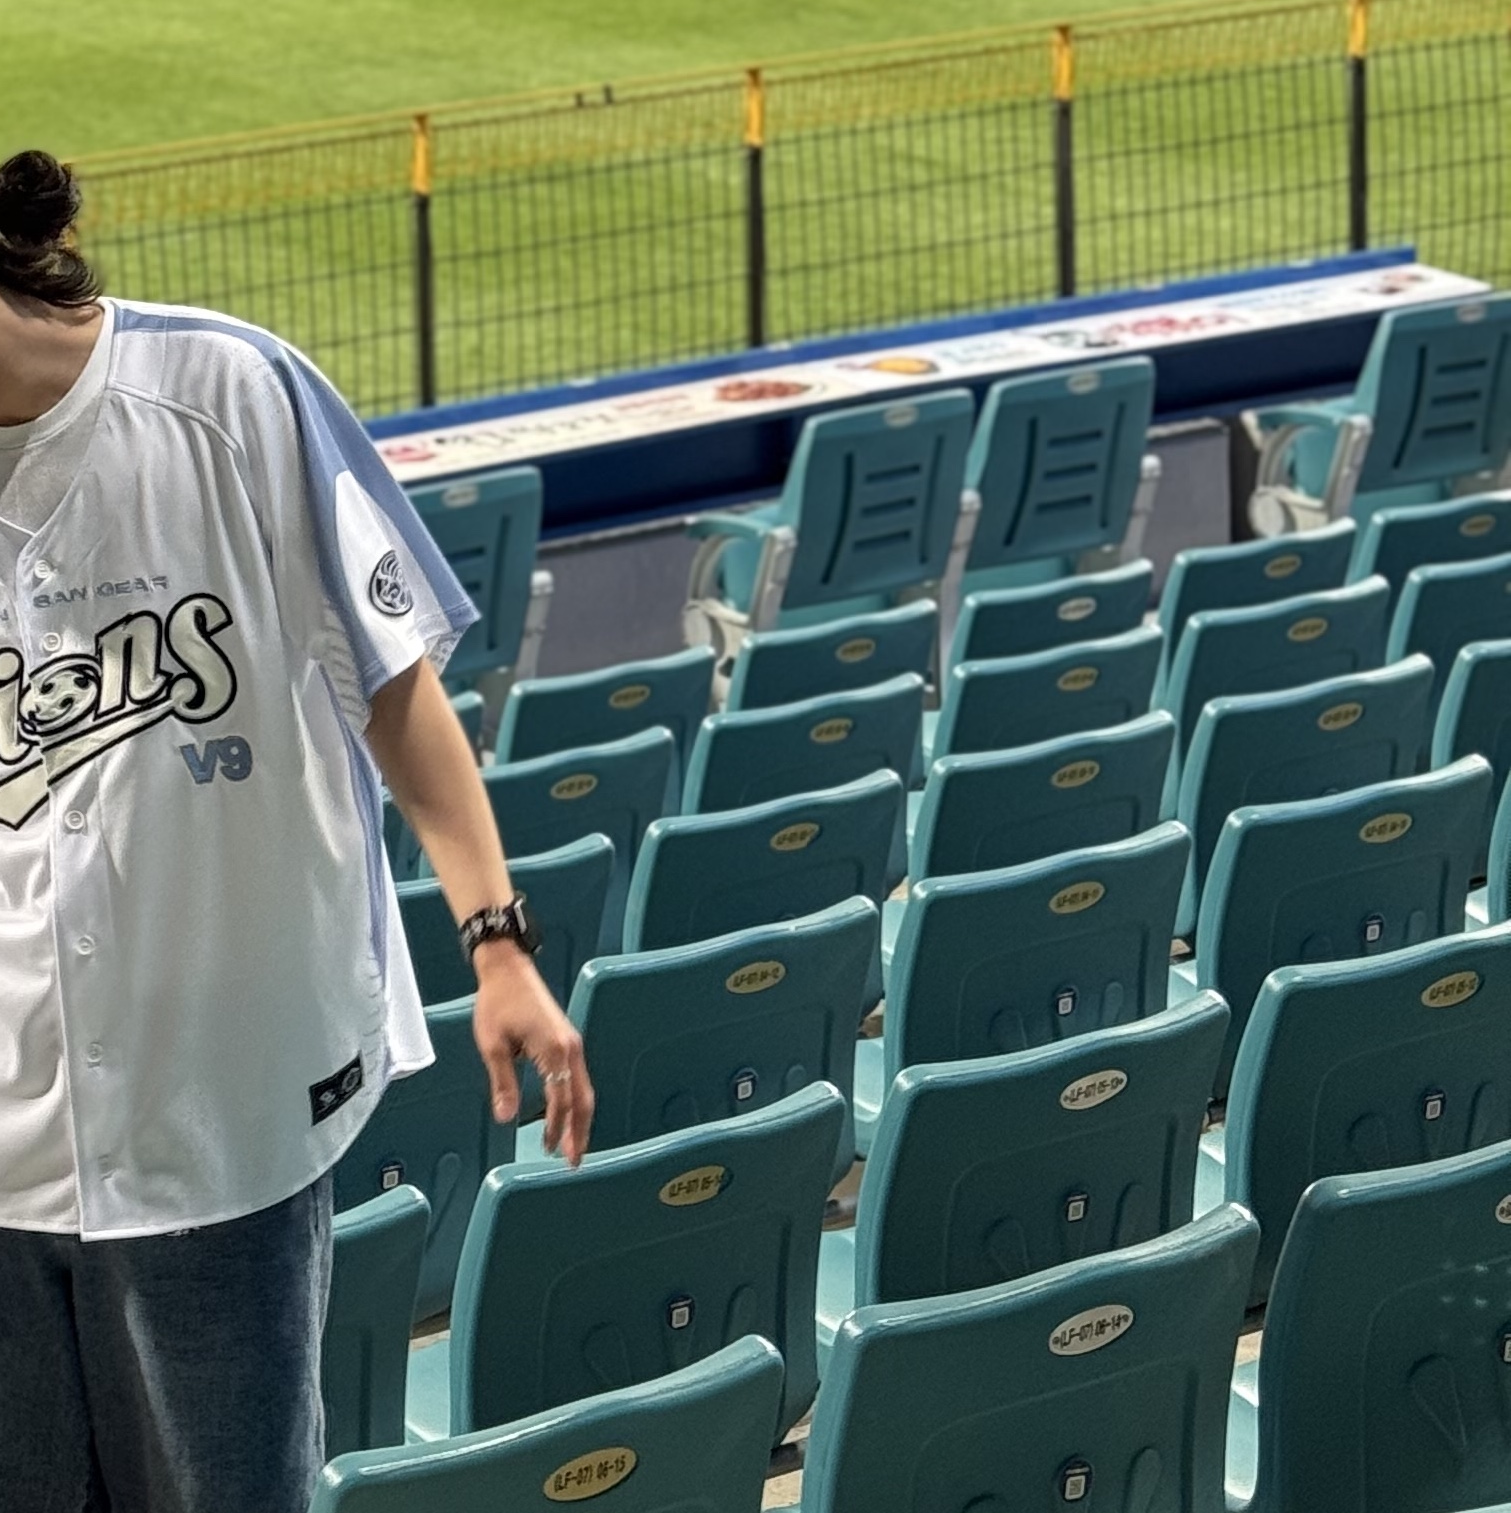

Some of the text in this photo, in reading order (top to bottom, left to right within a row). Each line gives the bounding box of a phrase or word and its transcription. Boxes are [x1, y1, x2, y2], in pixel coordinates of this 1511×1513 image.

[33, 584, 88, 609] SAN
[92, 575, 169, 600] GEAR
[179, 735, 253, 785] V9
